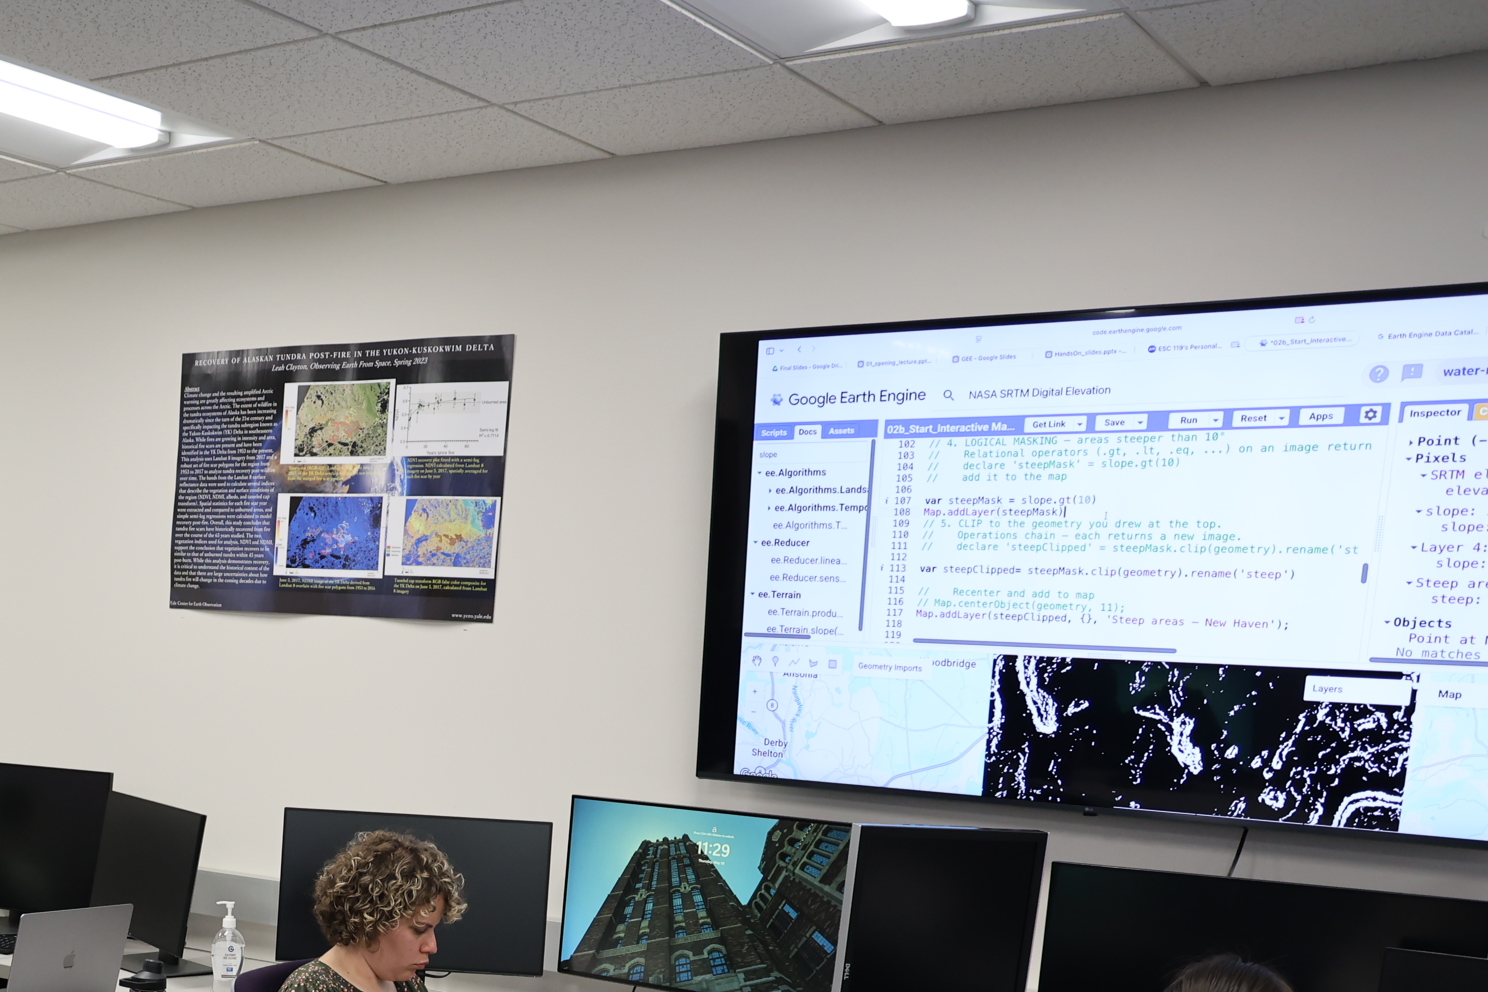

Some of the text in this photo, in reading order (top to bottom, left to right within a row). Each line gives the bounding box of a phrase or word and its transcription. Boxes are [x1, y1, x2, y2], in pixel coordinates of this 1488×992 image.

[195, 358, 229, 366] RECOVERY
[243, 355, 273, 363] ALASKAN
[309, 351, 351, 359] POST-FIRE
[383, 345, 462, 356] YUKON-KUSKOKWIM
[272, 364, 284, 372] Leah
[286, 363, 308, 372] Clayton,
[310, 361, 340, 370] Observing
[341, 360, 358, 368] Earth
[375, 359, 392, 368] Space,
[393, 358, 412, 367] Spring
[969, 385, 1111, 400] NASA SRTM Digital Elevation
[789, 390, 926, 408] Google Earth Engine
[1410, 408, 1462, 419] Inspector
[1033, 411, 1334, 429] Get Link Save Run Reset Apps
[761, 429, 787, 437] Scripts
[887, 424, 989, 435] 02b_Start_Interactive
[965, 434, 1198, 446] LOGICAL MASKING areas steeper than
[1417, 436, 1460, 446] Point
[964, 449, 1024, 459] Relational
[1032, 448, 1088, 459] operators
[1096, 447, 1126, 458] (.gt,
[1261, 444, 1274, 452] an
[1283, 442, 1318, 453] image
[1328, 442, 1372, 451] return
[963, 460, 1005, 470] declare
[1101, 458, 1180, 470] slope.gt(10)
[1416, 453, 1467, 463] Pixels
[765, 468, 826, 477] ee.Algorithms
[962, 472, 1067, 483] add it to the map
[1430, 470, 1465, 480] SRTM
[925, 495, 1096, 507] var steepMask slope.gt(10)
[924, 506, 1064, 518] Map.addLayer(steepMask)
[959, 519, 1222, 531] CLIP to the geometry you drew at the top.
[957, 531, 1241, 543] Operations chain each returns new image.
[957, 542, 998, 551] declare
[1421, 543, 1463, 554] Layer
[920, 565, 936, 573] var
[943, 563, 1021, 575] steepClipped=
[1416, 578, 1458, 590] Steep
[758, 591, 801, 599] ee.Terrain
[953, 588, 1095, 600] Recenter and add to map
[934, 599, 1125, 612] Map.centerObject(geometry, 11);
[916, 610, 1288, 630] Map.addLayer(steepClipped, 'Steep areas New Haven');
[1394, 618, 1452, 629] Objects
[858, 663, 922, 673] Geometry Imports
[1312, 684, 1343, 696] Layers
[1438, 690, 1462, 701] Map
[764, 738, 788, 748] Derby
[752, 749, 783, 758] Shelton
[696, 841, 731, 858] 11:29
